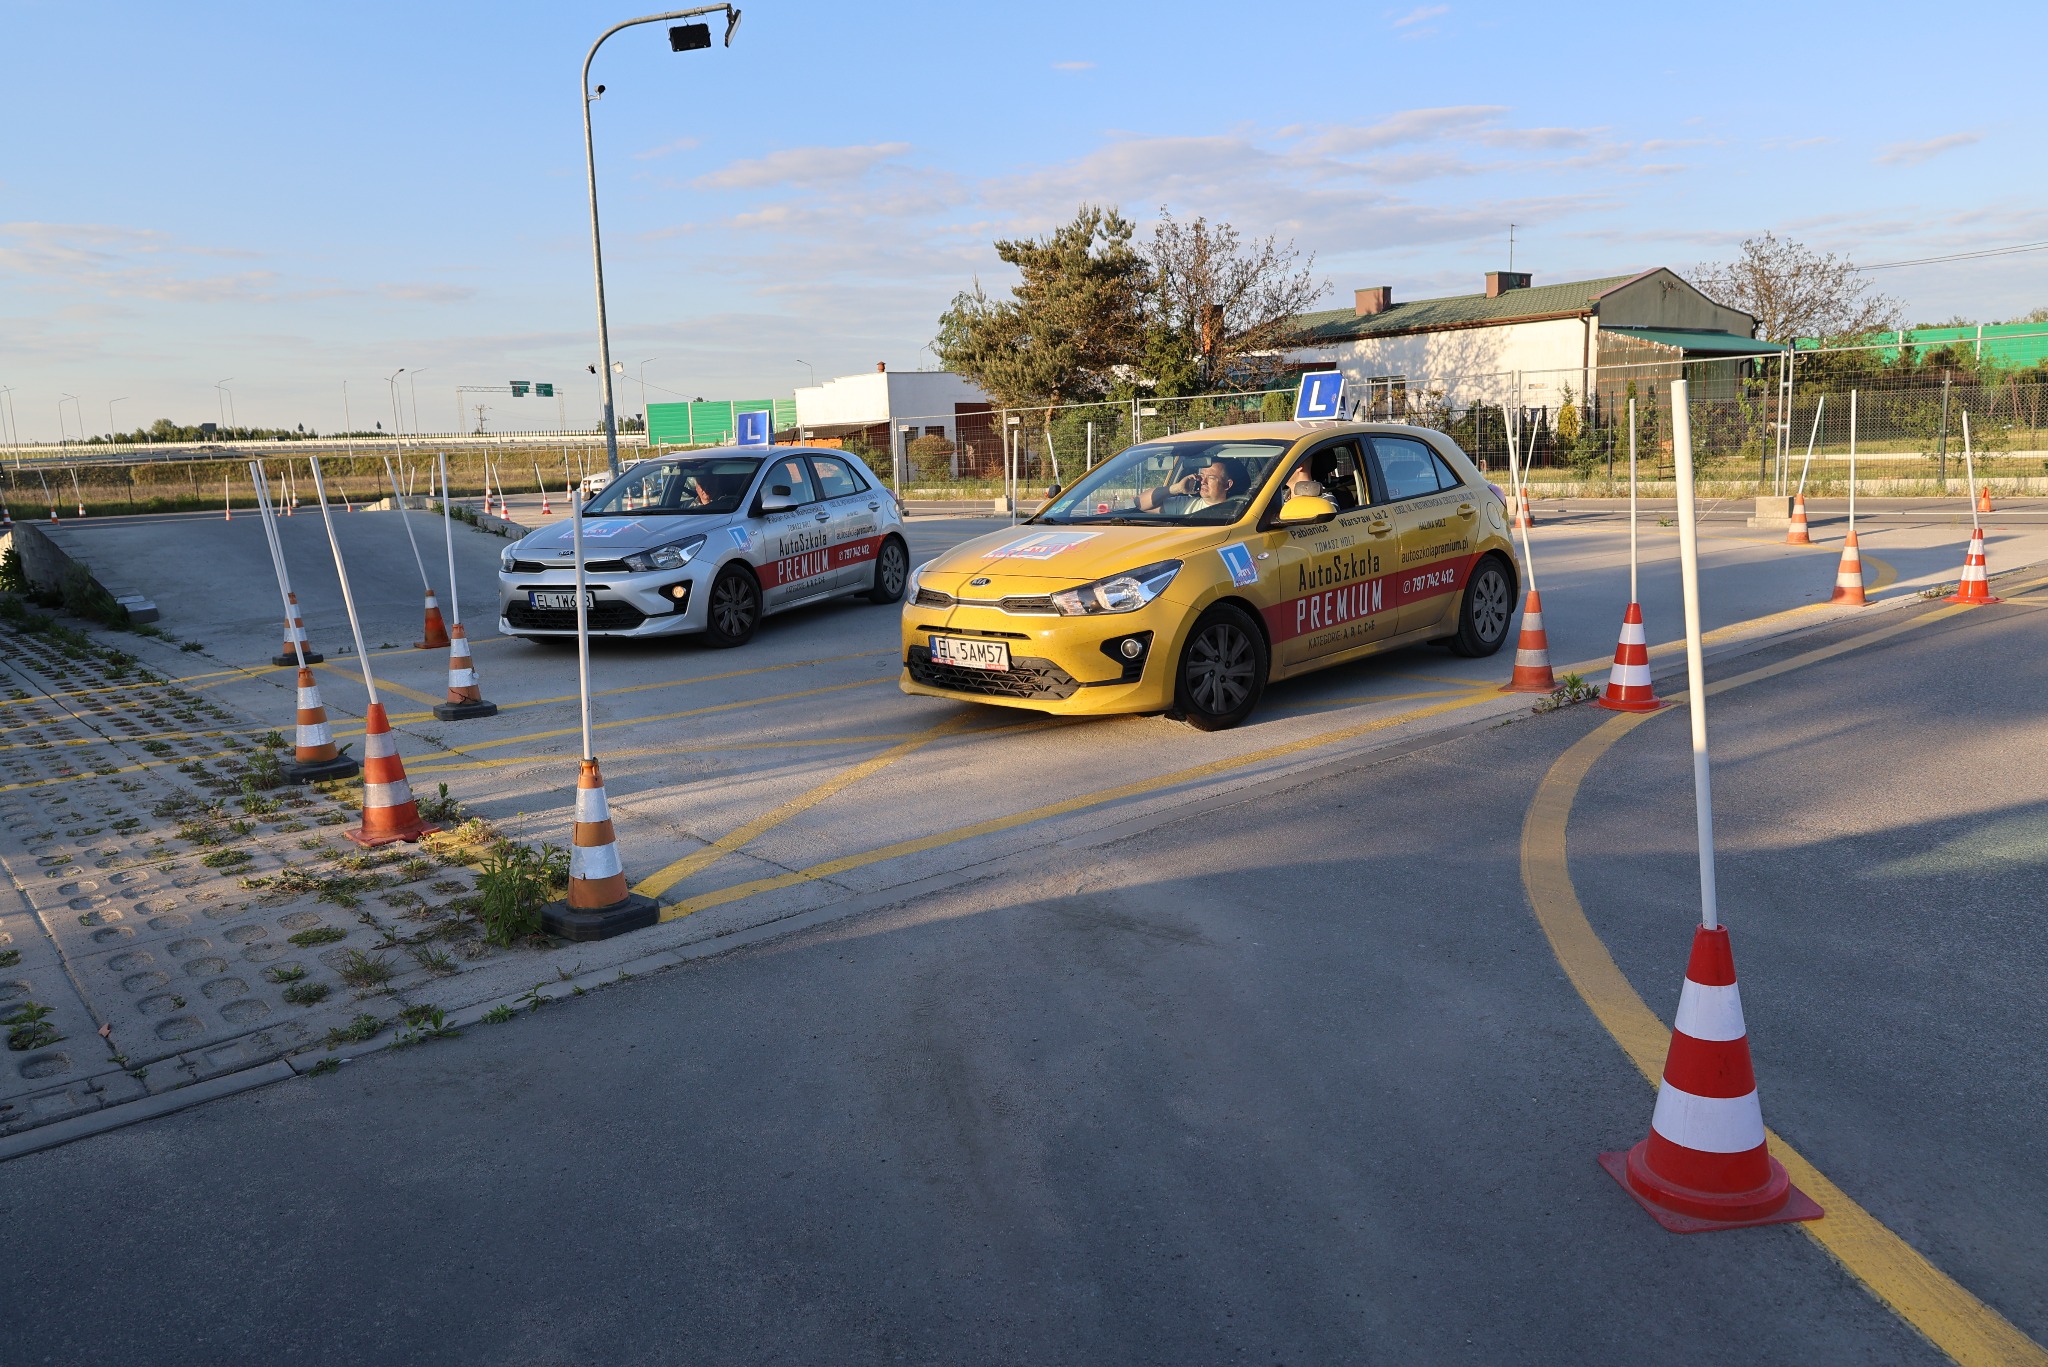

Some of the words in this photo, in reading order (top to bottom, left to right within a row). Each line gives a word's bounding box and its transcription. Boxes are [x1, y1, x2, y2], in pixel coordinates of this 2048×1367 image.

[1309, 381, 1327, 412] L
[747, 418, 760, 440] L
[779, 529, 827, 557] AutoSzkoła
[1315, 538, 1339, 553] TOMASZ
[1340, 535, 1355, 548] HOLZ
[778, 549, 829, 584] PREMIUM
[1299, 549, 1380, 592] AutoSzkoła
[1412, 575, 1426, 593] 797
[1426, 571, 1440, 589] 742
[1441, 568, 1454, 584] 412
[536, 594, 552, 608] EL
[1296, 579, 1382, 634] PREMIUM
[939, 640, 956, 660] EL
[960, 642, 1003, 664] 5AM57
